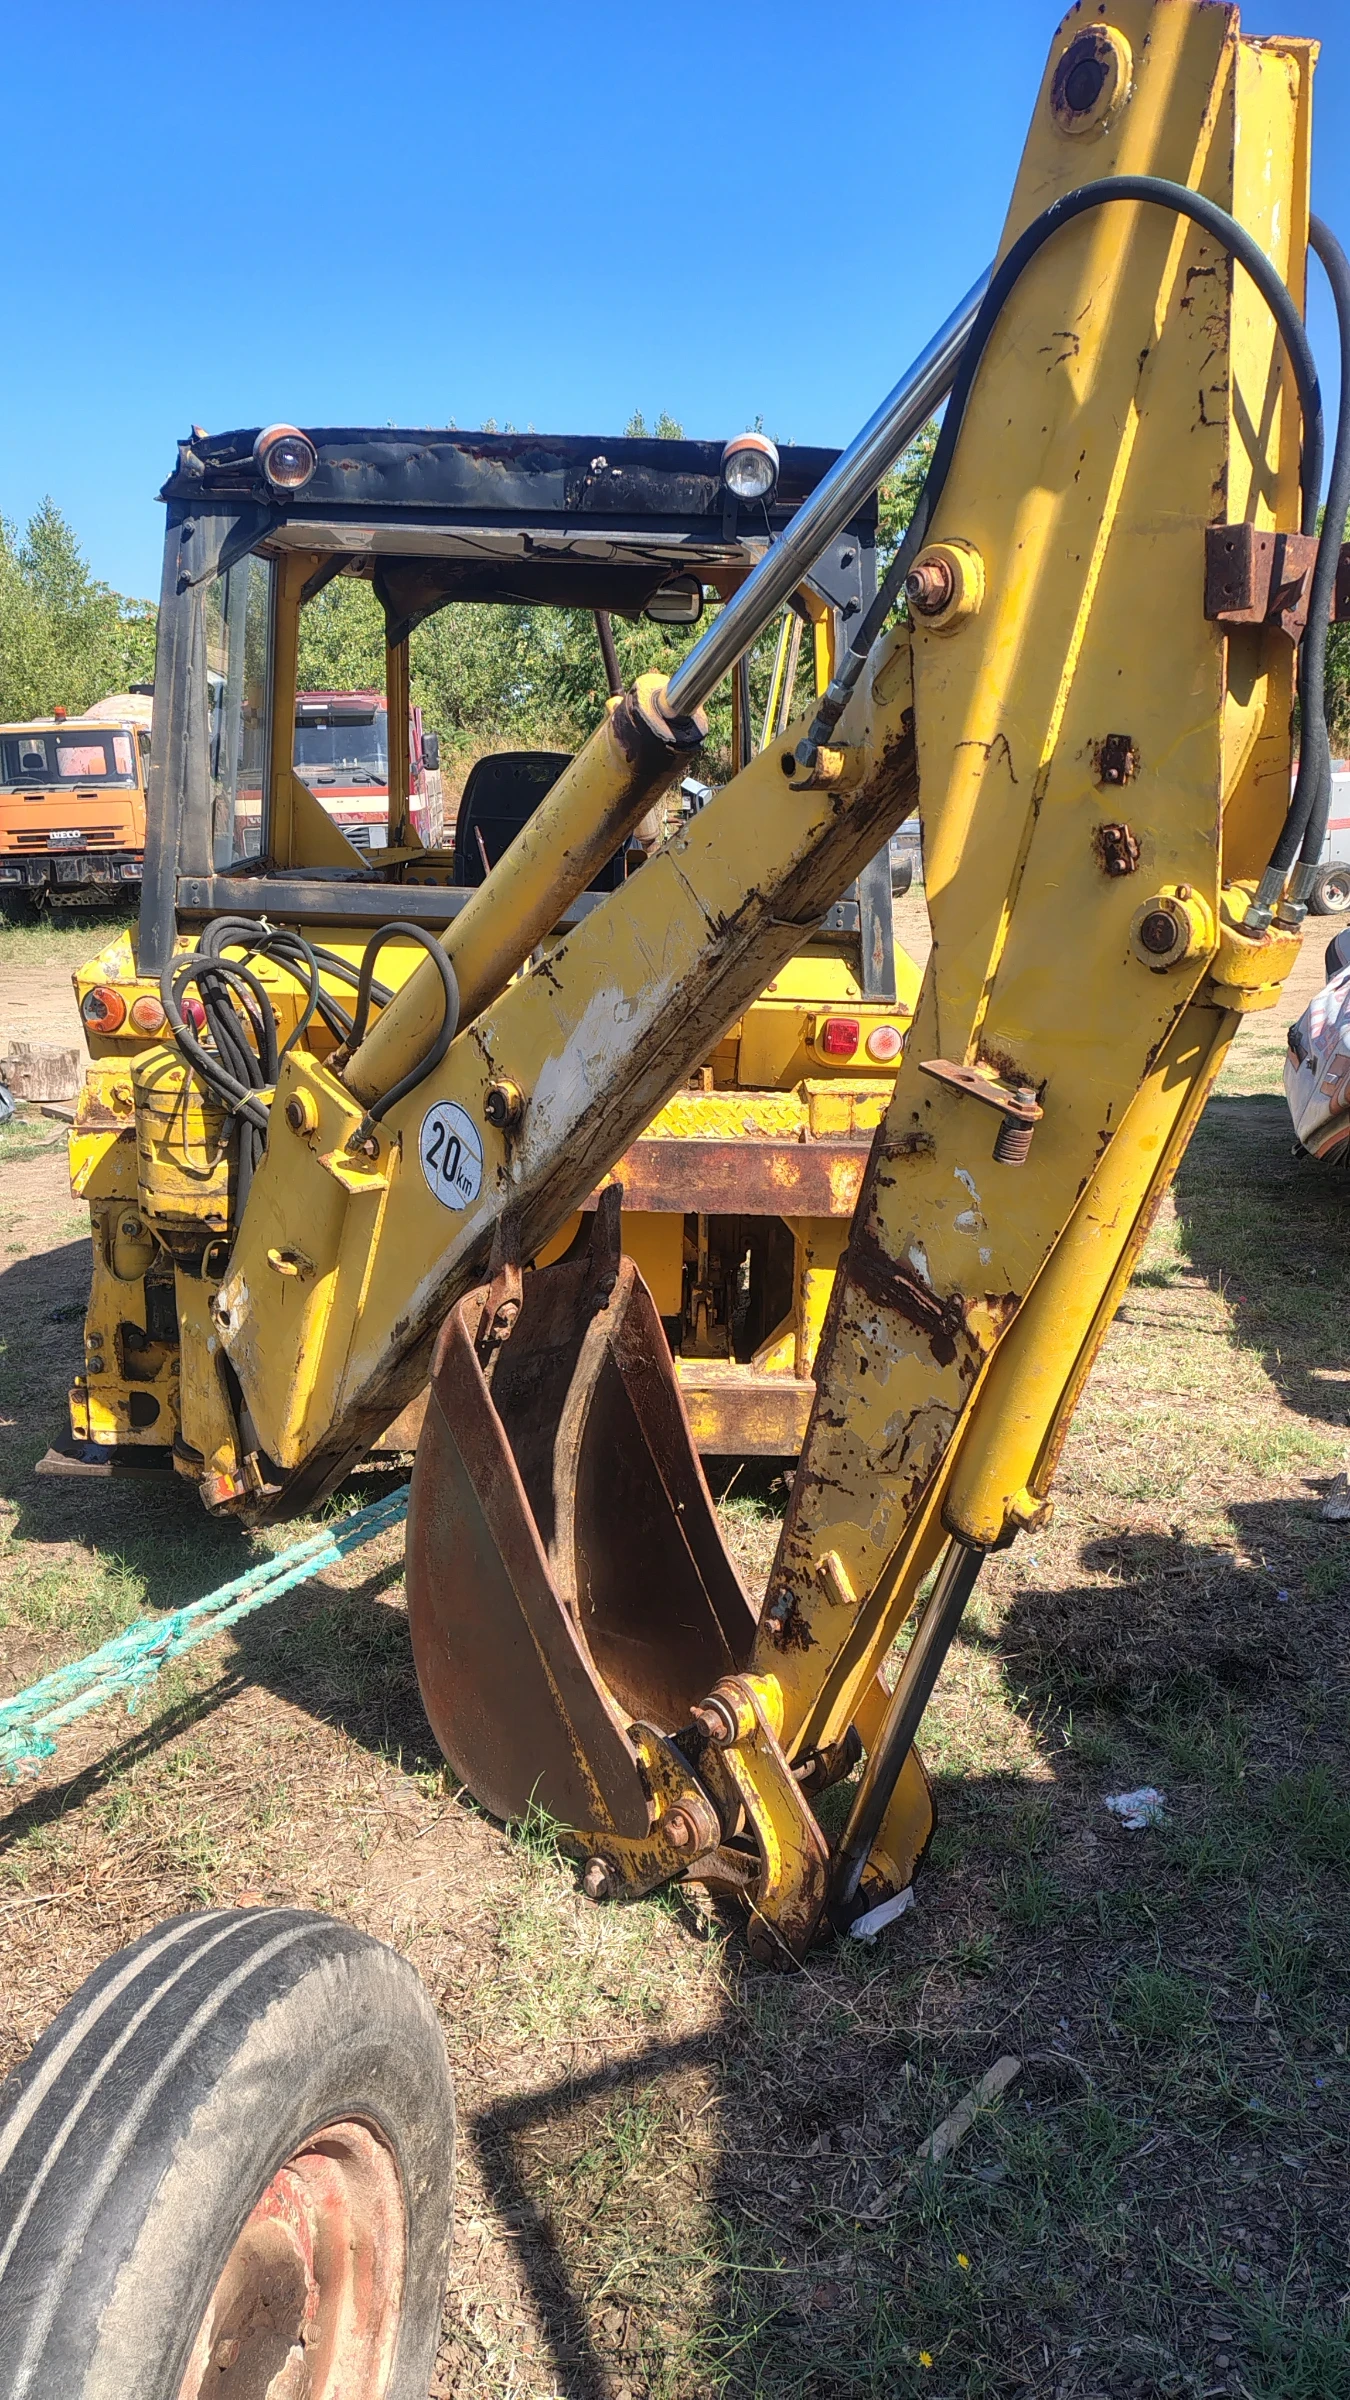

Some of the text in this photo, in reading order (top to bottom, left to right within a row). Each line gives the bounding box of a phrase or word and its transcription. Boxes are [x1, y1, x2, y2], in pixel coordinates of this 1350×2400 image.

[49, 830, 81, 839] IVECO
[426, 1121, 472, 1197] 20 km
